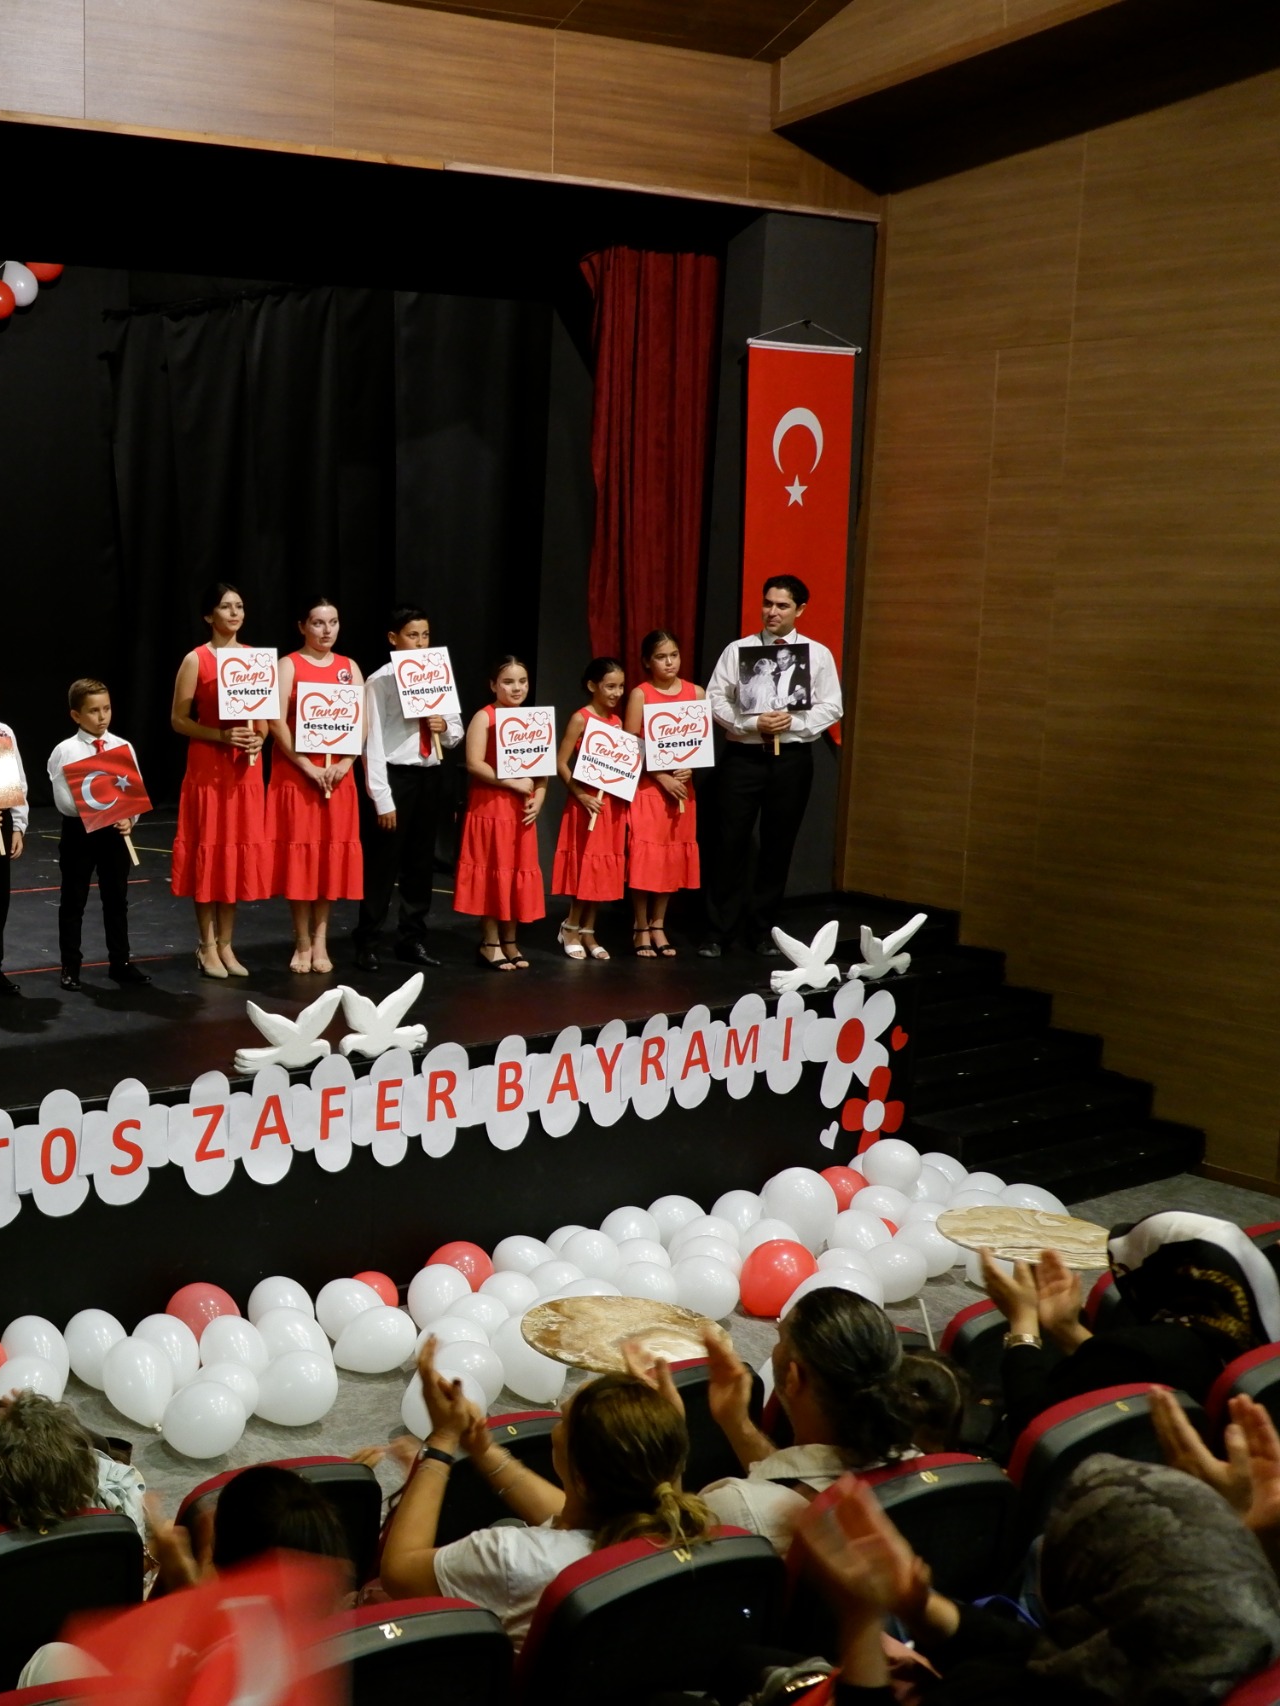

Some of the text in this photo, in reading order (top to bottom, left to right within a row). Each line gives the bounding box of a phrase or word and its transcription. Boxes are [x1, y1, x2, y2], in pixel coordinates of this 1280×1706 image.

[231, 670, 266, 685] Tango
[407, 668, 441, 684] Tango
[227, 686, 272, 697] şevkattir
[402, 684, 453, 697] arkadaşlıktır
[310, 705, 349, 721] Tango
[303, 721, 354, 732] destektir
[658, 722, 697, 738] Tango
[508, 727, 544, 743] Tango
[505, 744, 549, 755] neşedir
[657, 738, 703, 749] özendir
[595, 742, 630, 764] Tango
[581, 753, 636, 780] gülümsemedir
[192, 1069, 458, 1163] ZAFER
[495, 1016, 794, 1114] BAYRAMI
